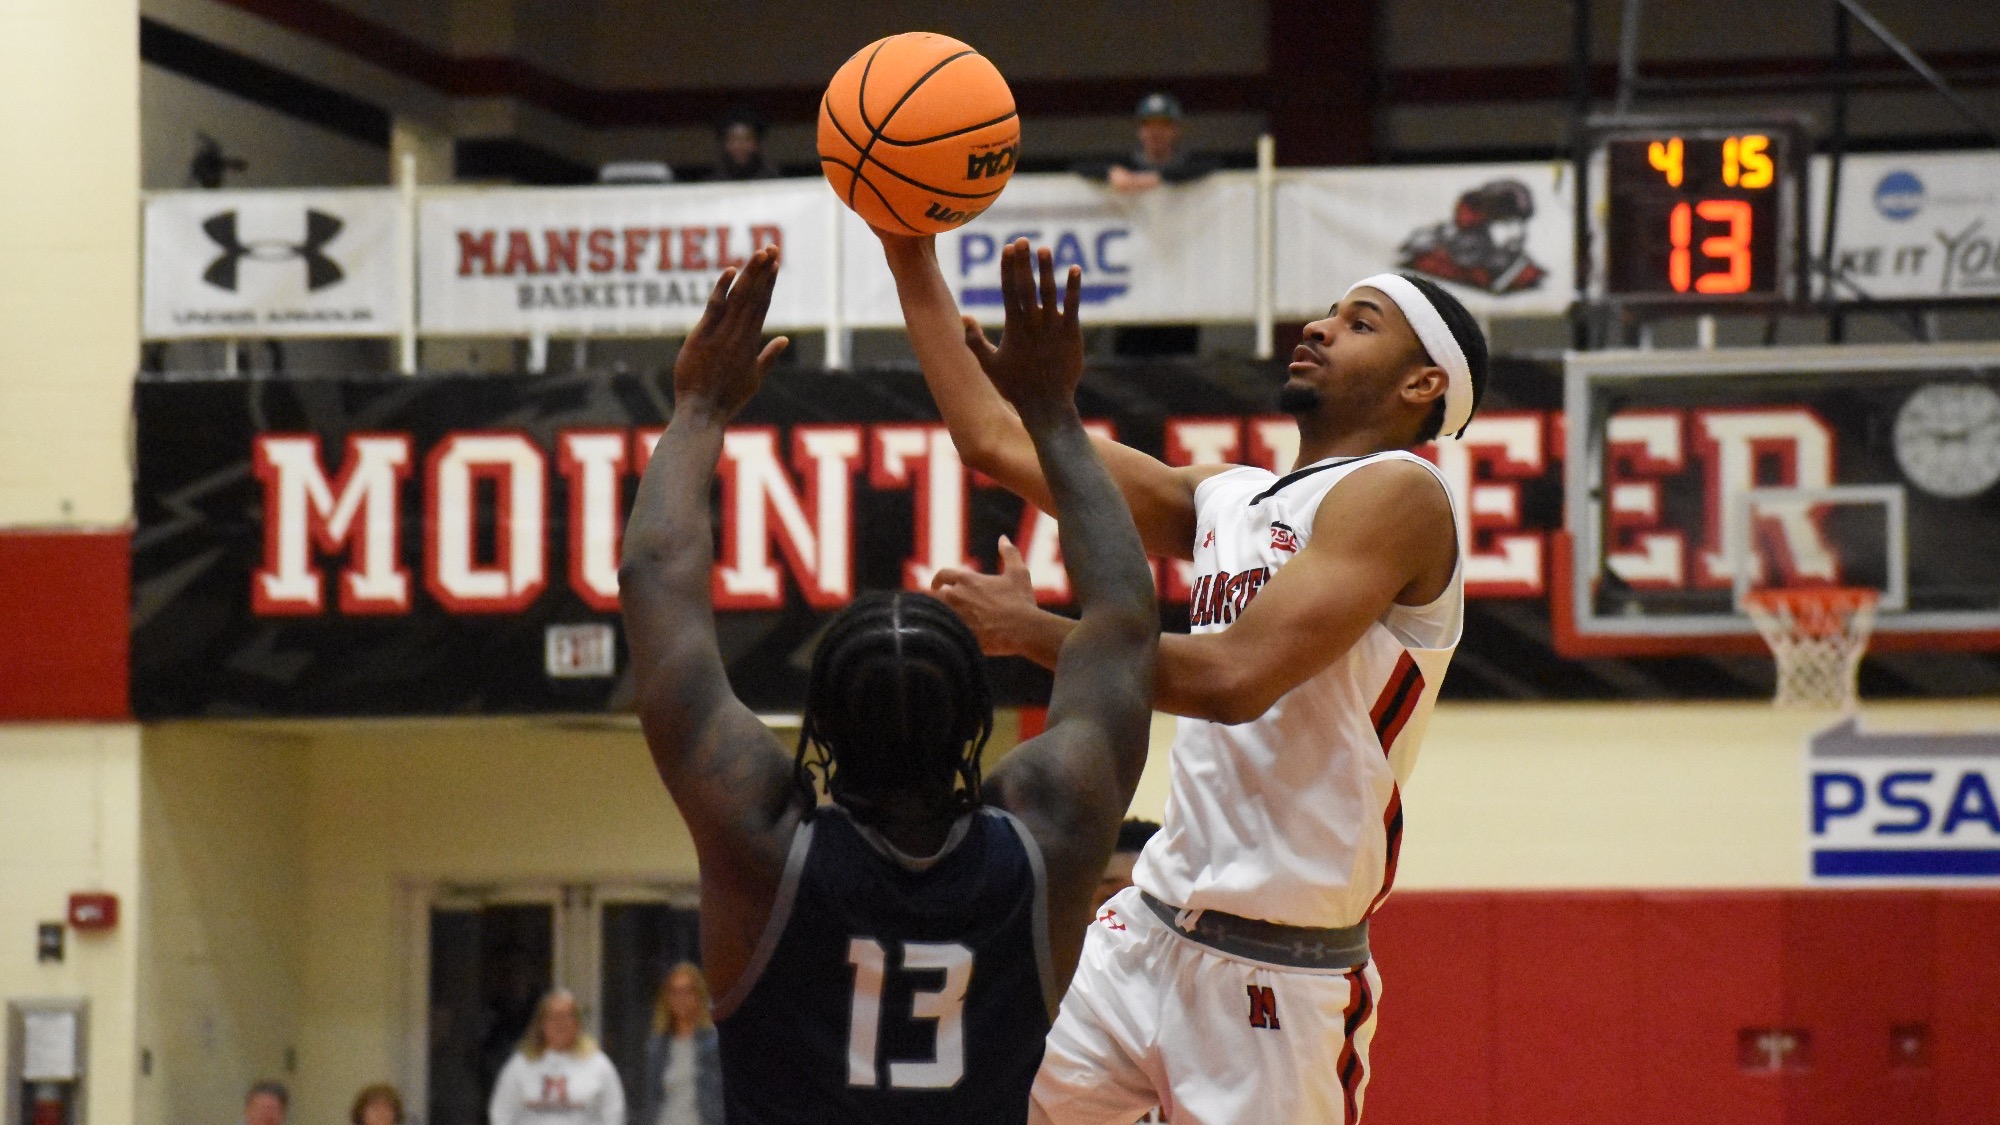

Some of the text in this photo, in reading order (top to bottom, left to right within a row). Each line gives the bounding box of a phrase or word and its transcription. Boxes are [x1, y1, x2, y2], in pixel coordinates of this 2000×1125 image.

[966, 143, 1018, 180] CAA
[1648, 134, 1775, 190] 4 15
[456, 224, 785, 277] MANSFIELD
[1668, 200, 1753, 294] 13
[251, 405, 1840, 617] MOUNTEER
[1811, 769, 2000, 836] PSA
[847, 938, 974, 1089] 13
